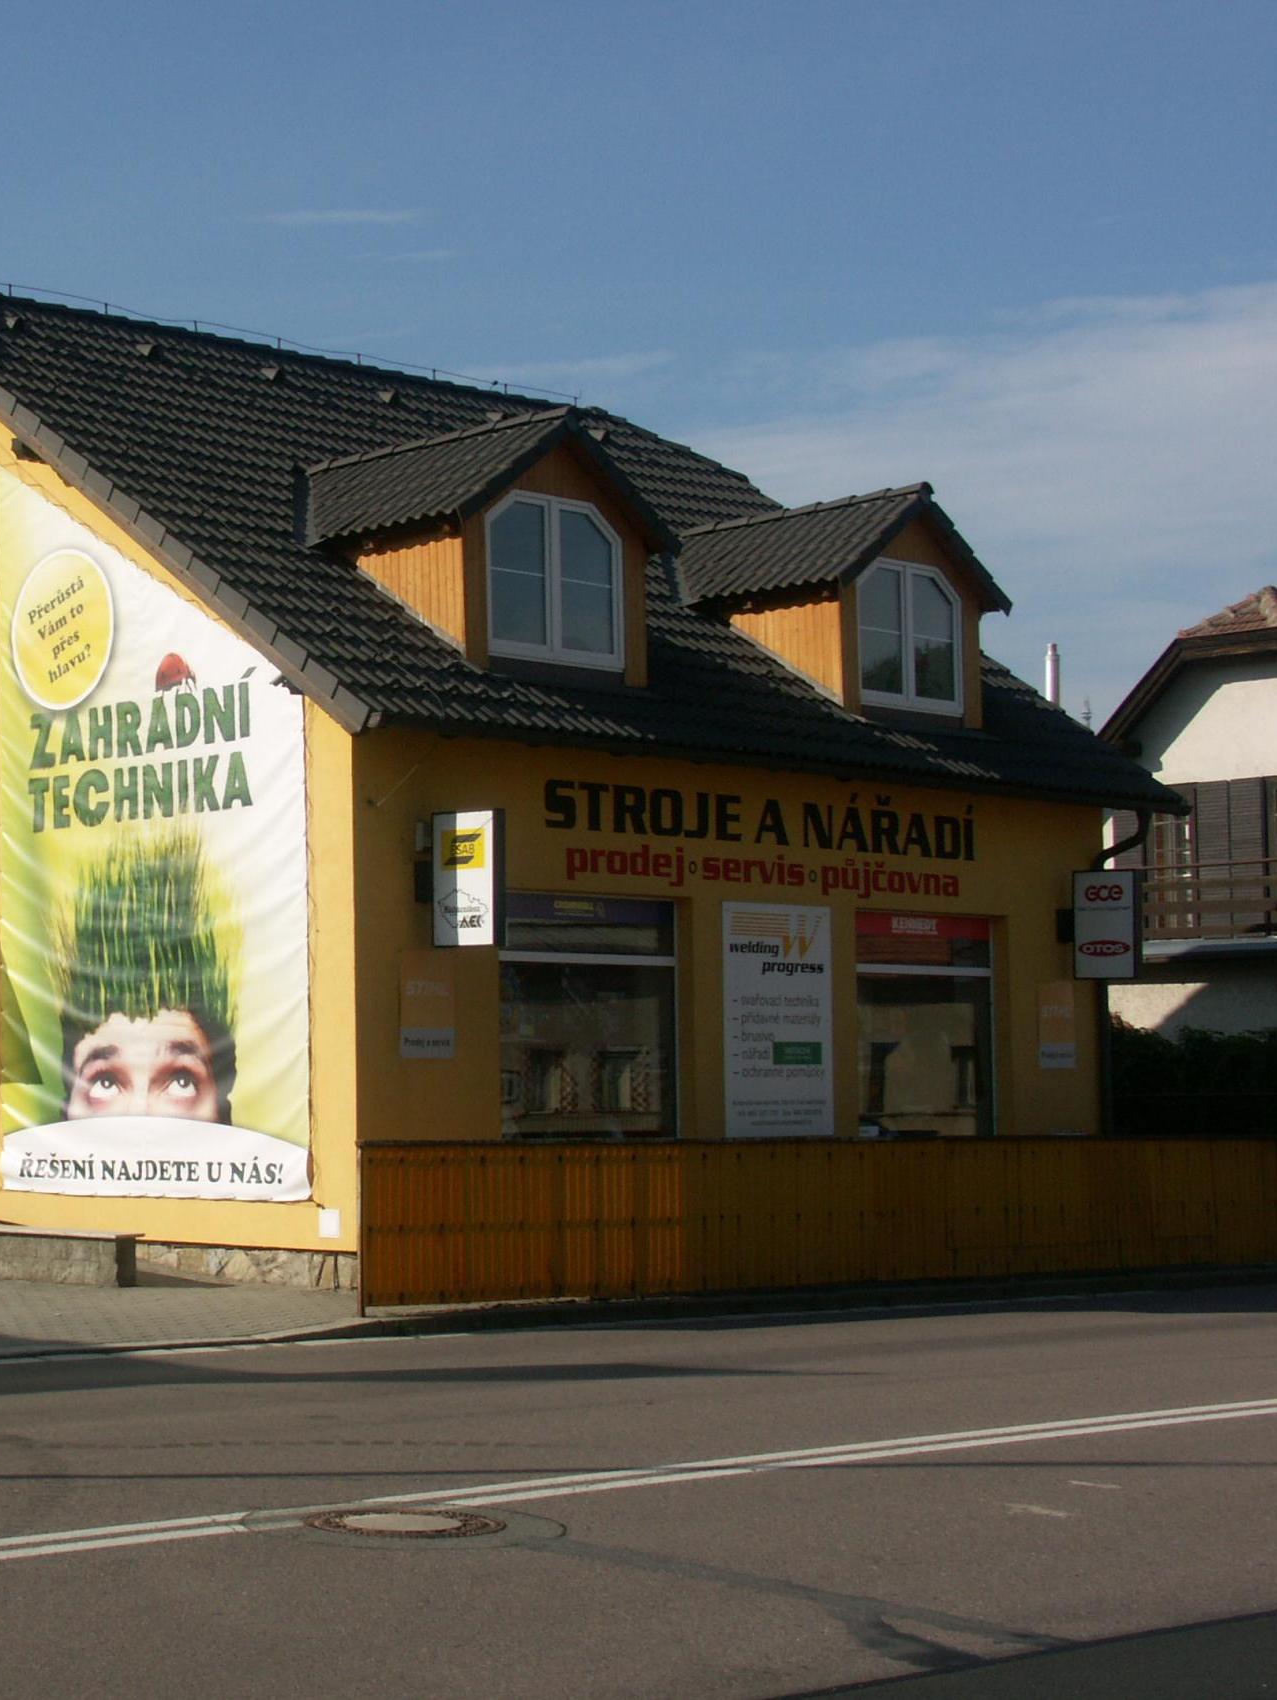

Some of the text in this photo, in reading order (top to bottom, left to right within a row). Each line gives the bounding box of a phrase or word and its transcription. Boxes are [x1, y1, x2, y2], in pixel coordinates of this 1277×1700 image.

[27, 576, 84, 625] Přerůstá
[37, 603, 84, 641] Vám to
[47, 643, 92, 684] hlavu?
[52, 630, 81, 660] přes
[29, 666, 257, 770] ZAHRADNÍ
[28, 751, 254, 834] TECHNIKA
[544, 779, 974, 861] STROJE A NÁŘADÍ
[565, 844, 960, 899] prodej servis půjčovna
[729, 941, 780, 958] welding
[761, 960, 825, 977] progress
[18, 1151, 285, 1185] ŘEŠENÍ NAJDETE U NÁS!
